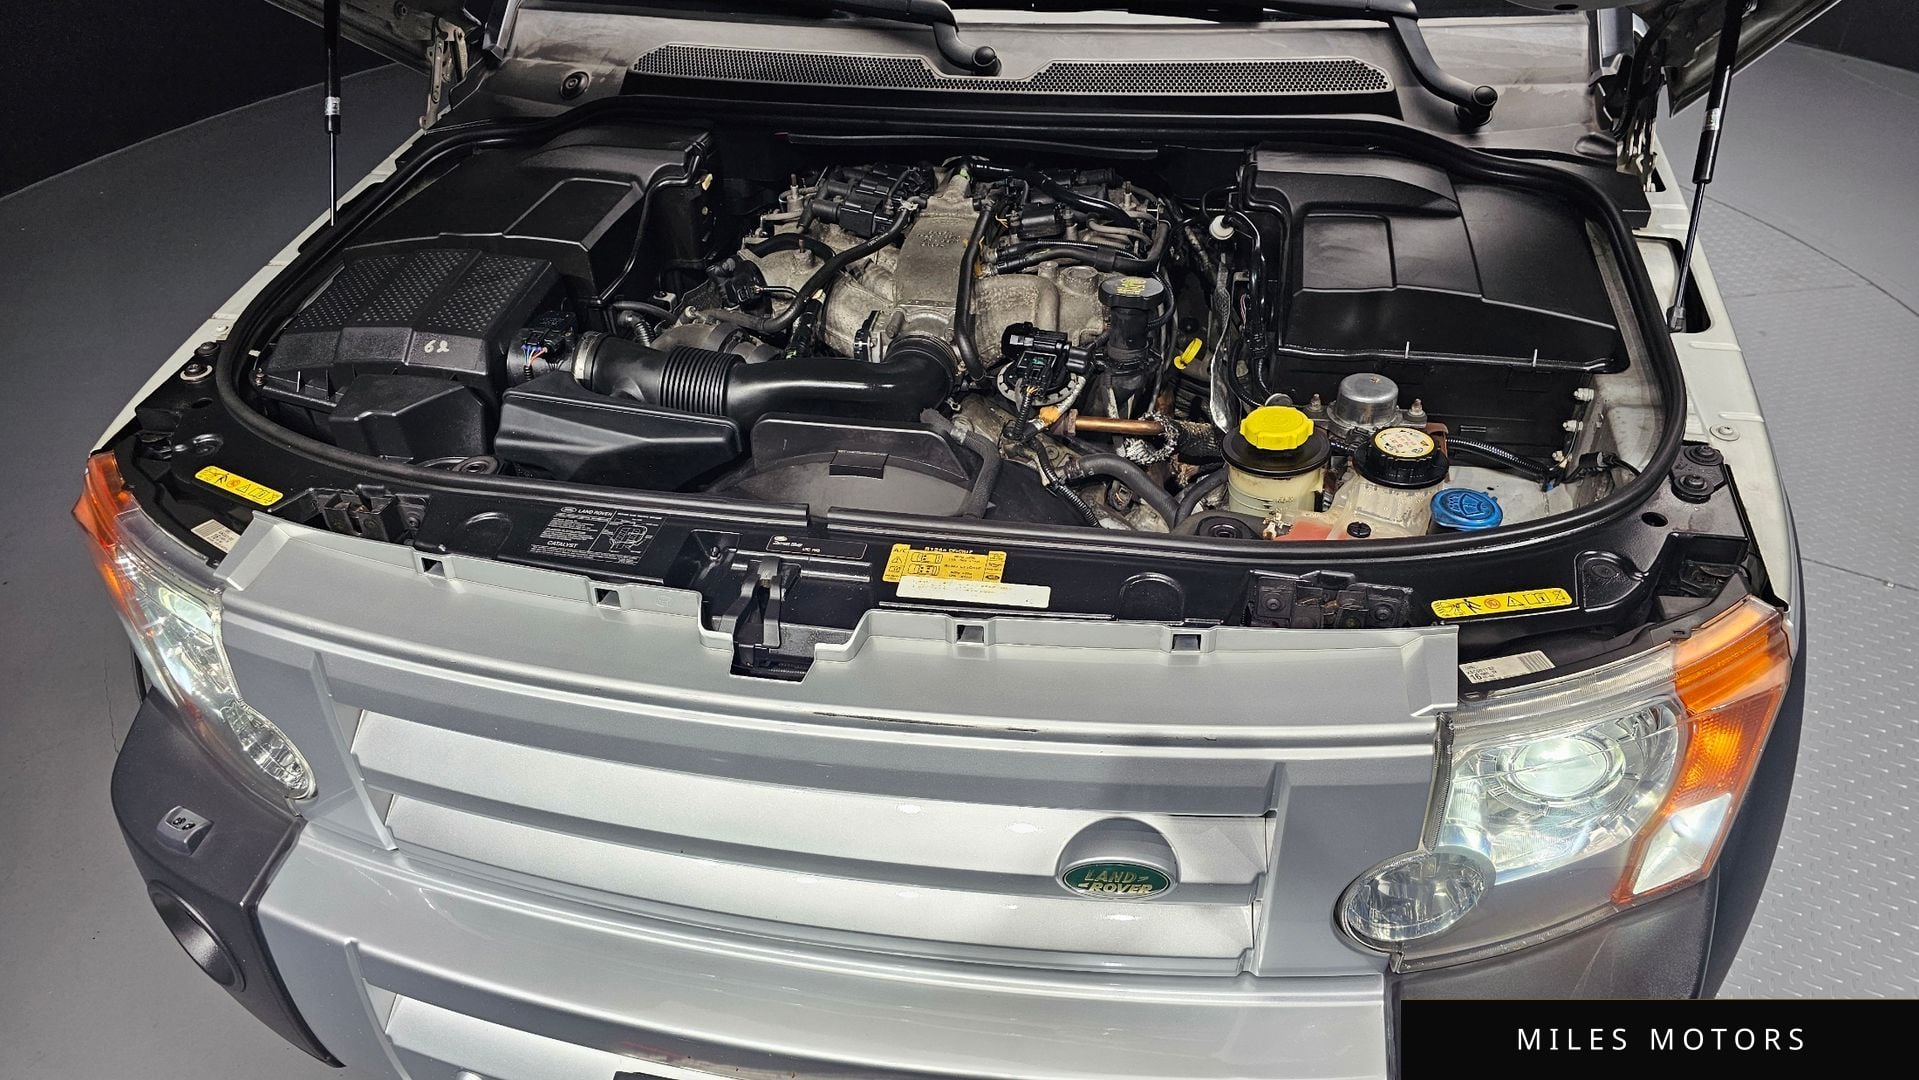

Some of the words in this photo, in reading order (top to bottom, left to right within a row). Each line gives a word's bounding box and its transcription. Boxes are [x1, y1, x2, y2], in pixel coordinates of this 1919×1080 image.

[547, 540, 578, 549] CATALYST
[1084, 869, 1136, 883] LAND
[1088, 882, 1153, 894] ROVER
